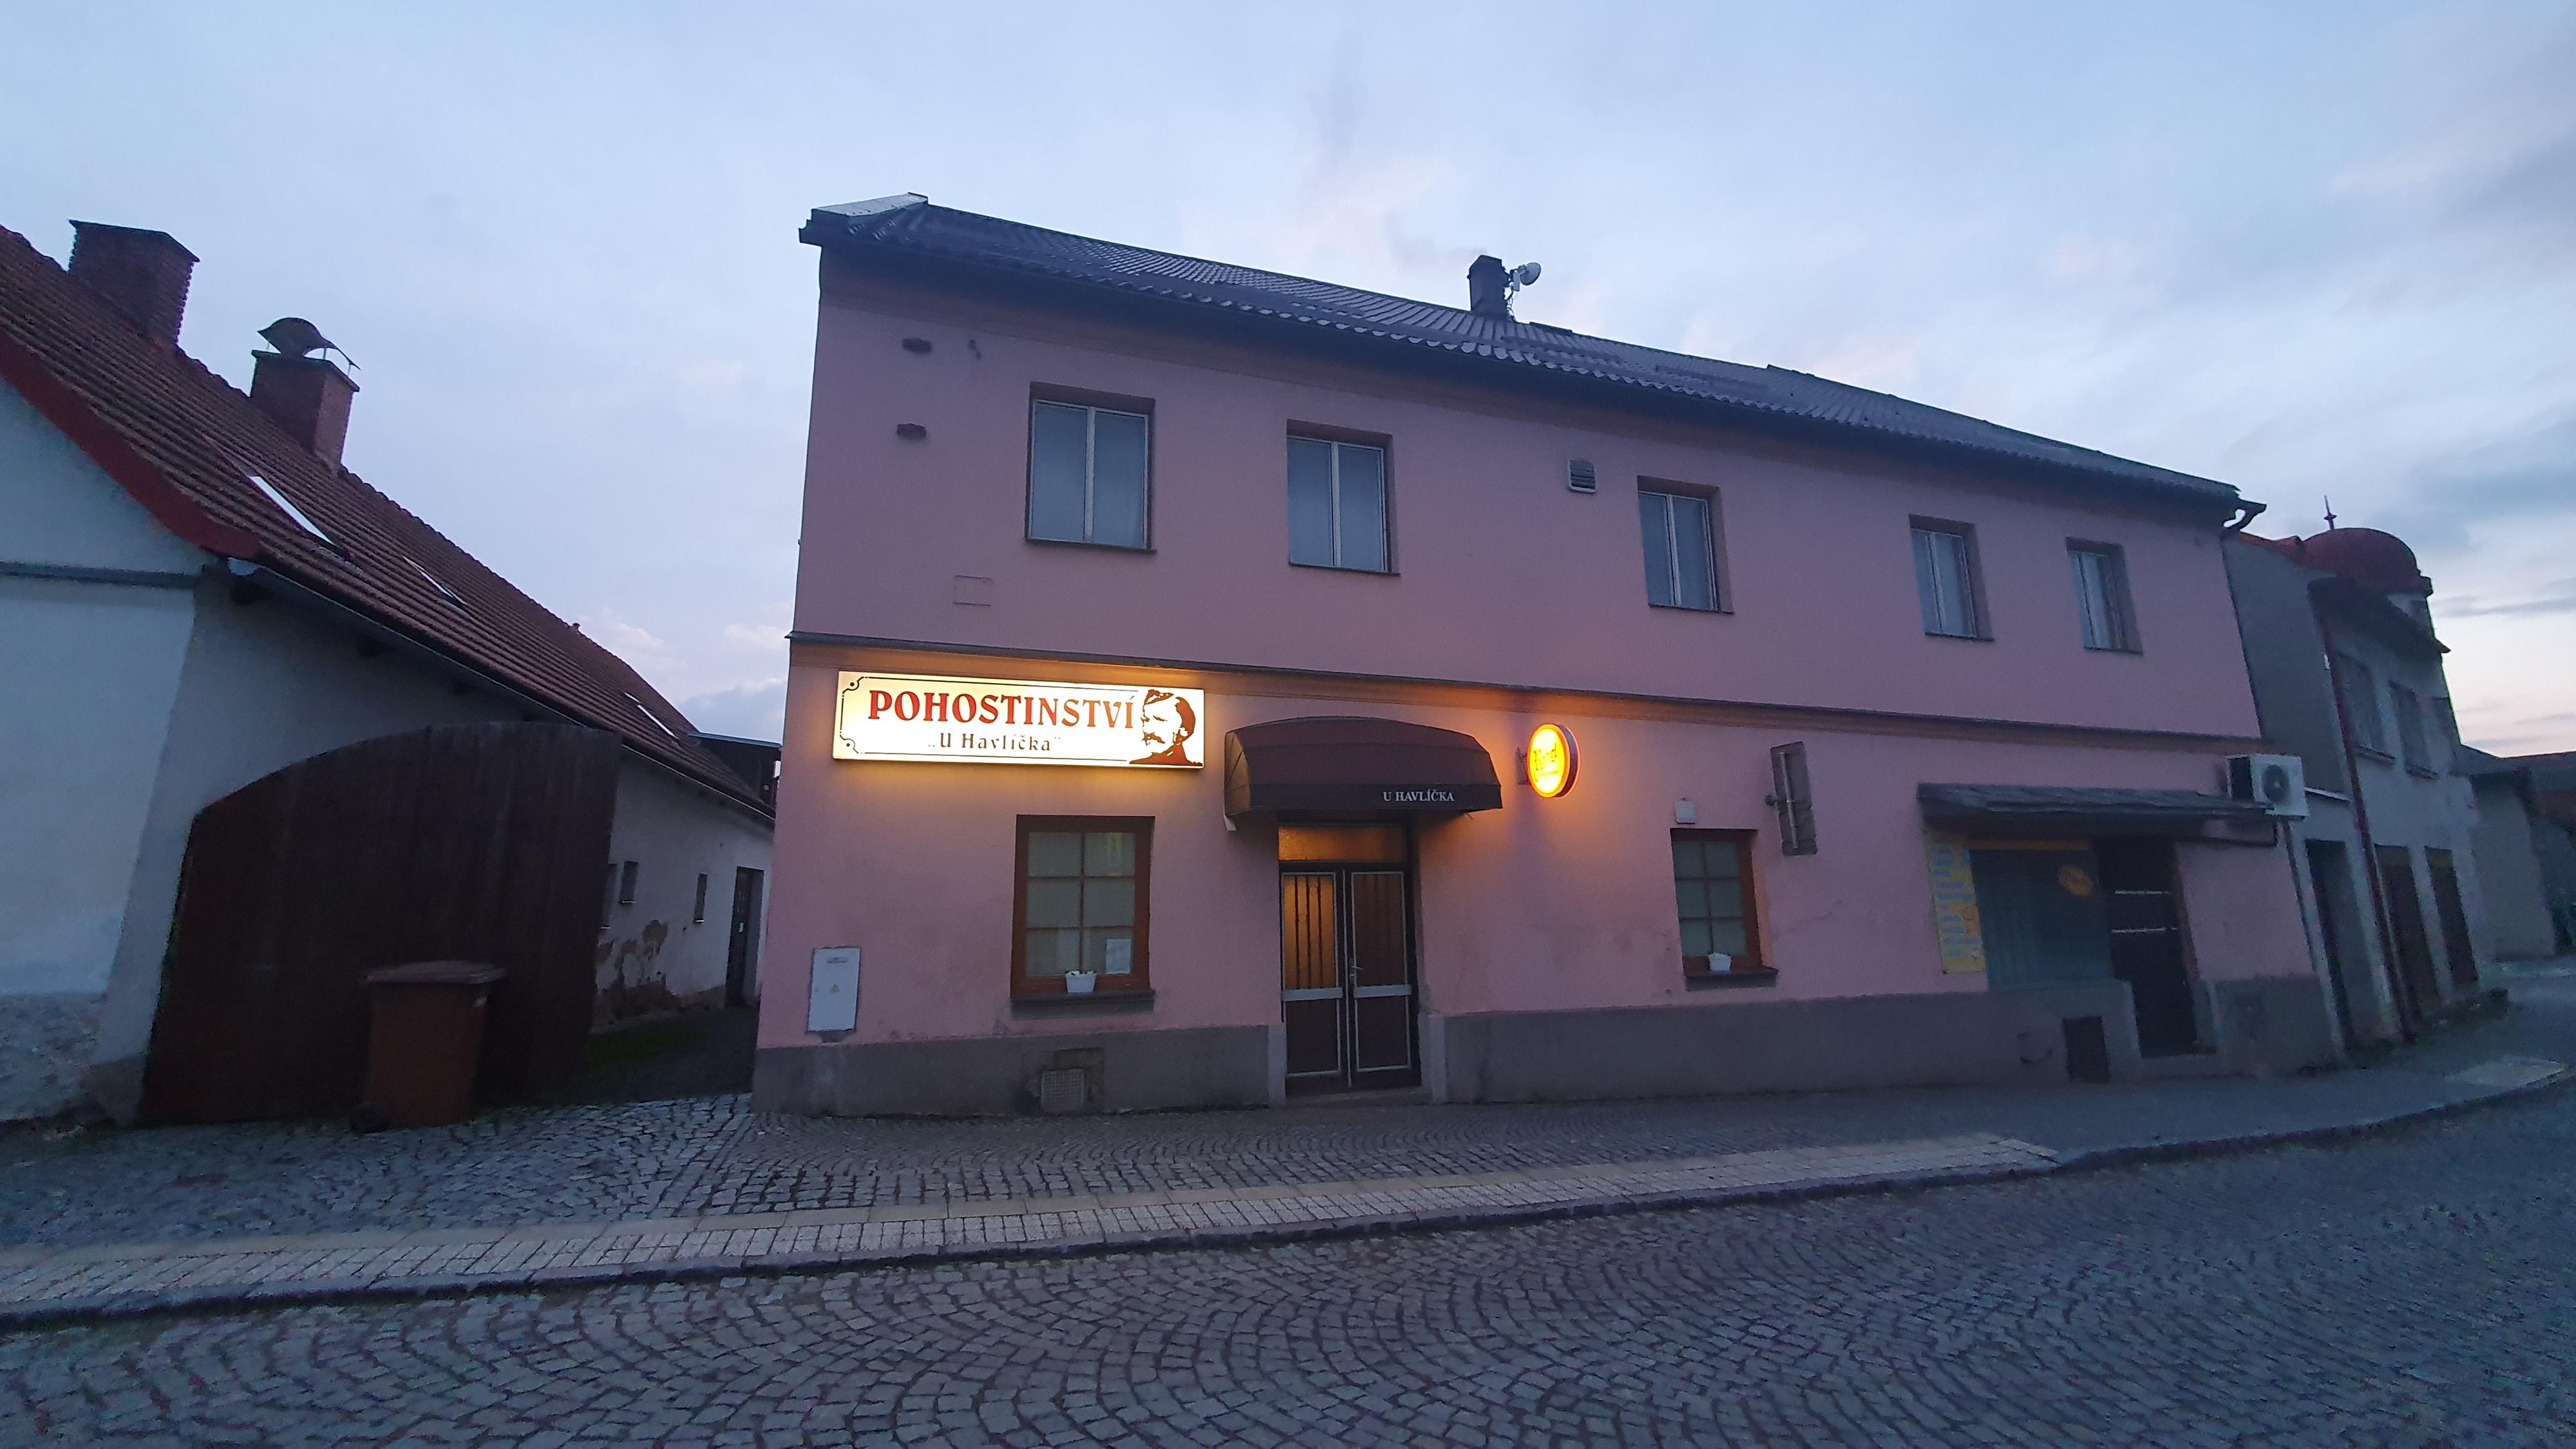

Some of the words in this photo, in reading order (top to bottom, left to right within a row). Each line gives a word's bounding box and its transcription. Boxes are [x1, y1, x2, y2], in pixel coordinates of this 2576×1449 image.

[868, 690, 1135, 728] POHOSTINSTVÍ
[1383, 791, 1392, 801] U
[1395, 789, 1454, 801] HAVLÍČKA
